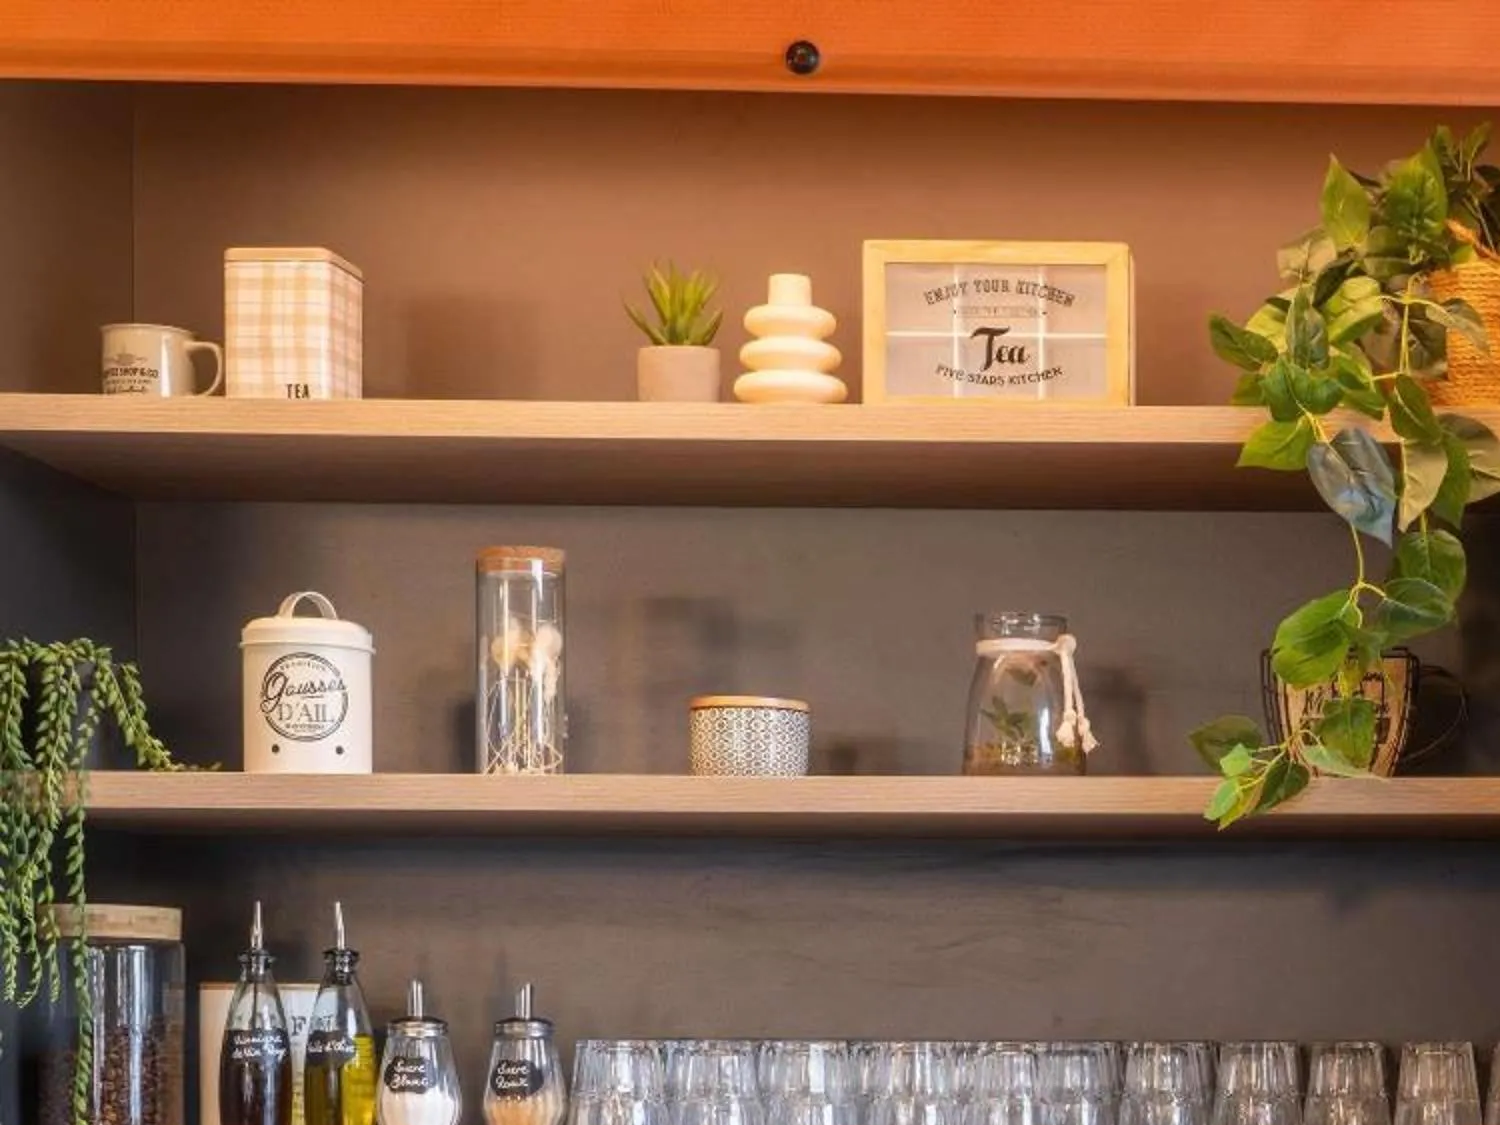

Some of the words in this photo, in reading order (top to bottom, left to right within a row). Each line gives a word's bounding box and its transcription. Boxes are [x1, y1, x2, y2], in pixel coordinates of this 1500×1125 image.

[923, 279, 969, 305] ENJOY
[973, 278, 1010, 293] YOUR
[1015, 279, 1076, 307] KITCHEN
[969, 326, 1031, 372] Tea
[935, 363, 966, 382] FIVE
[967, 373, 1005, 387] STARS
[1008, 366, 1064, 386] KITCHEN
[286, 383, 310, 399] TEA
[277, 702, 336, 722] D'AIL
